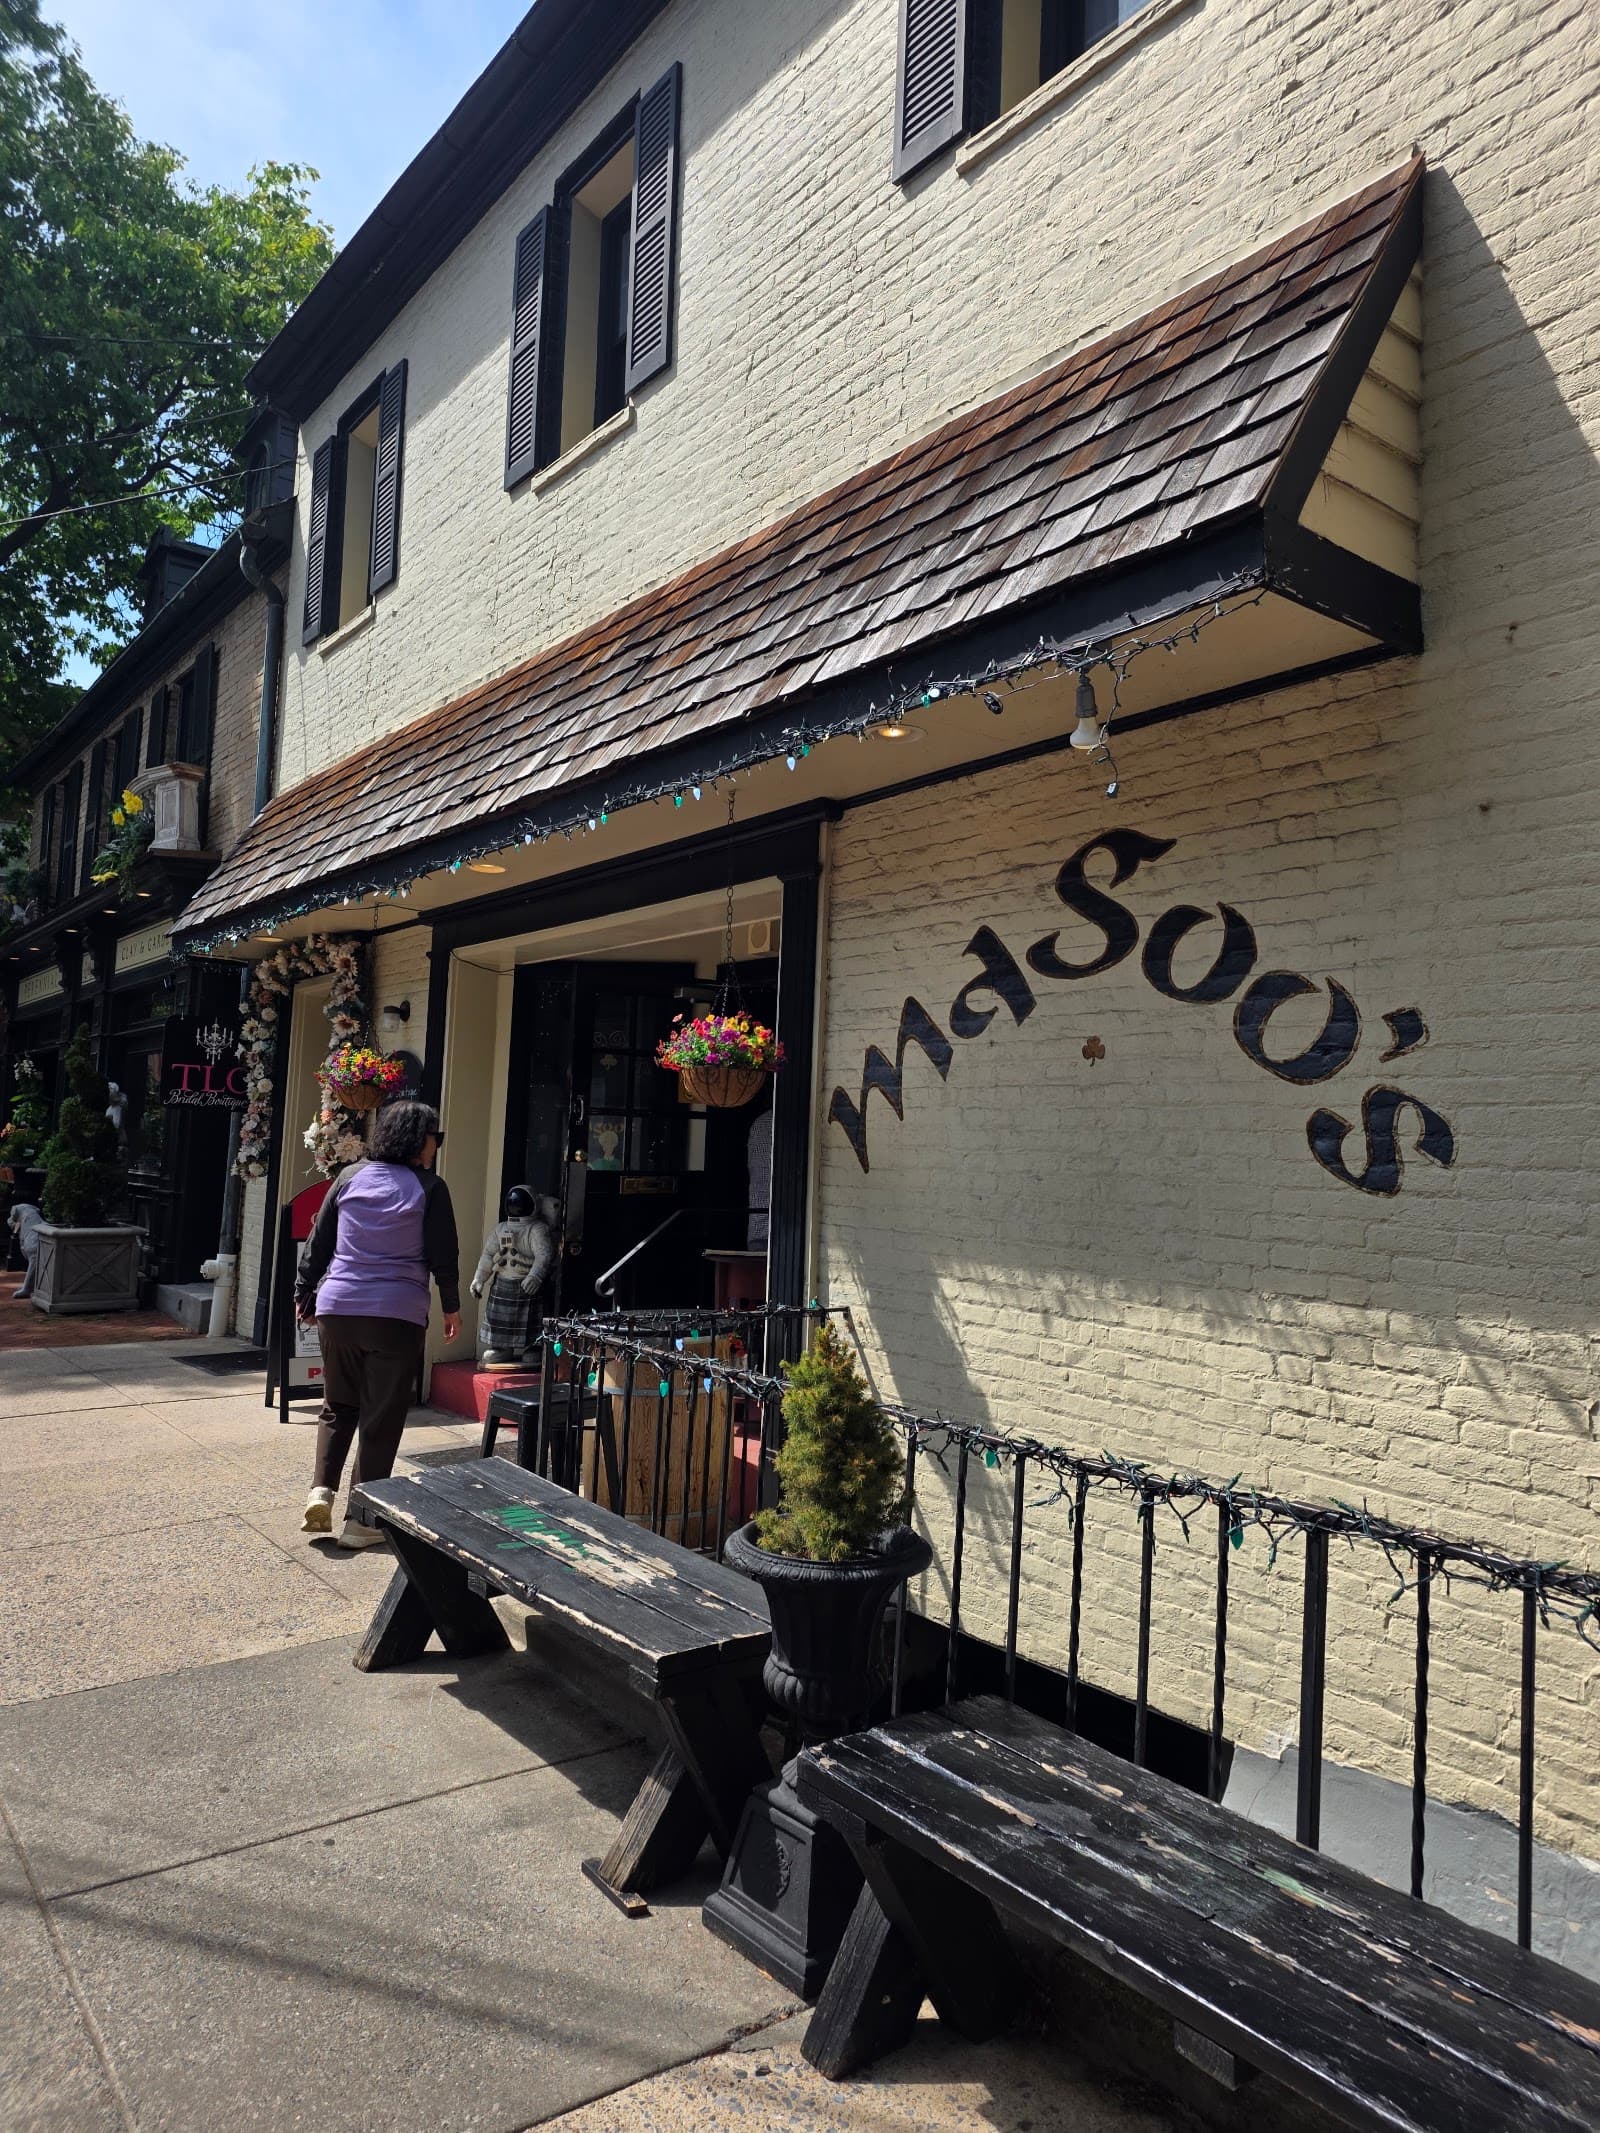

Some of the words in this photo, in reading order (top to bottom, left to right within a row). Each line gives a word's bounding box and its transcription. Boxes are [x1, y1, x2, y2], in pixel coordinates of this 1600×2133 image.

[121, 943, 138, 961] CLAY
[171, 1063, 249, 1095] TLC
[163, 1088, 202, 1105] Bridal
